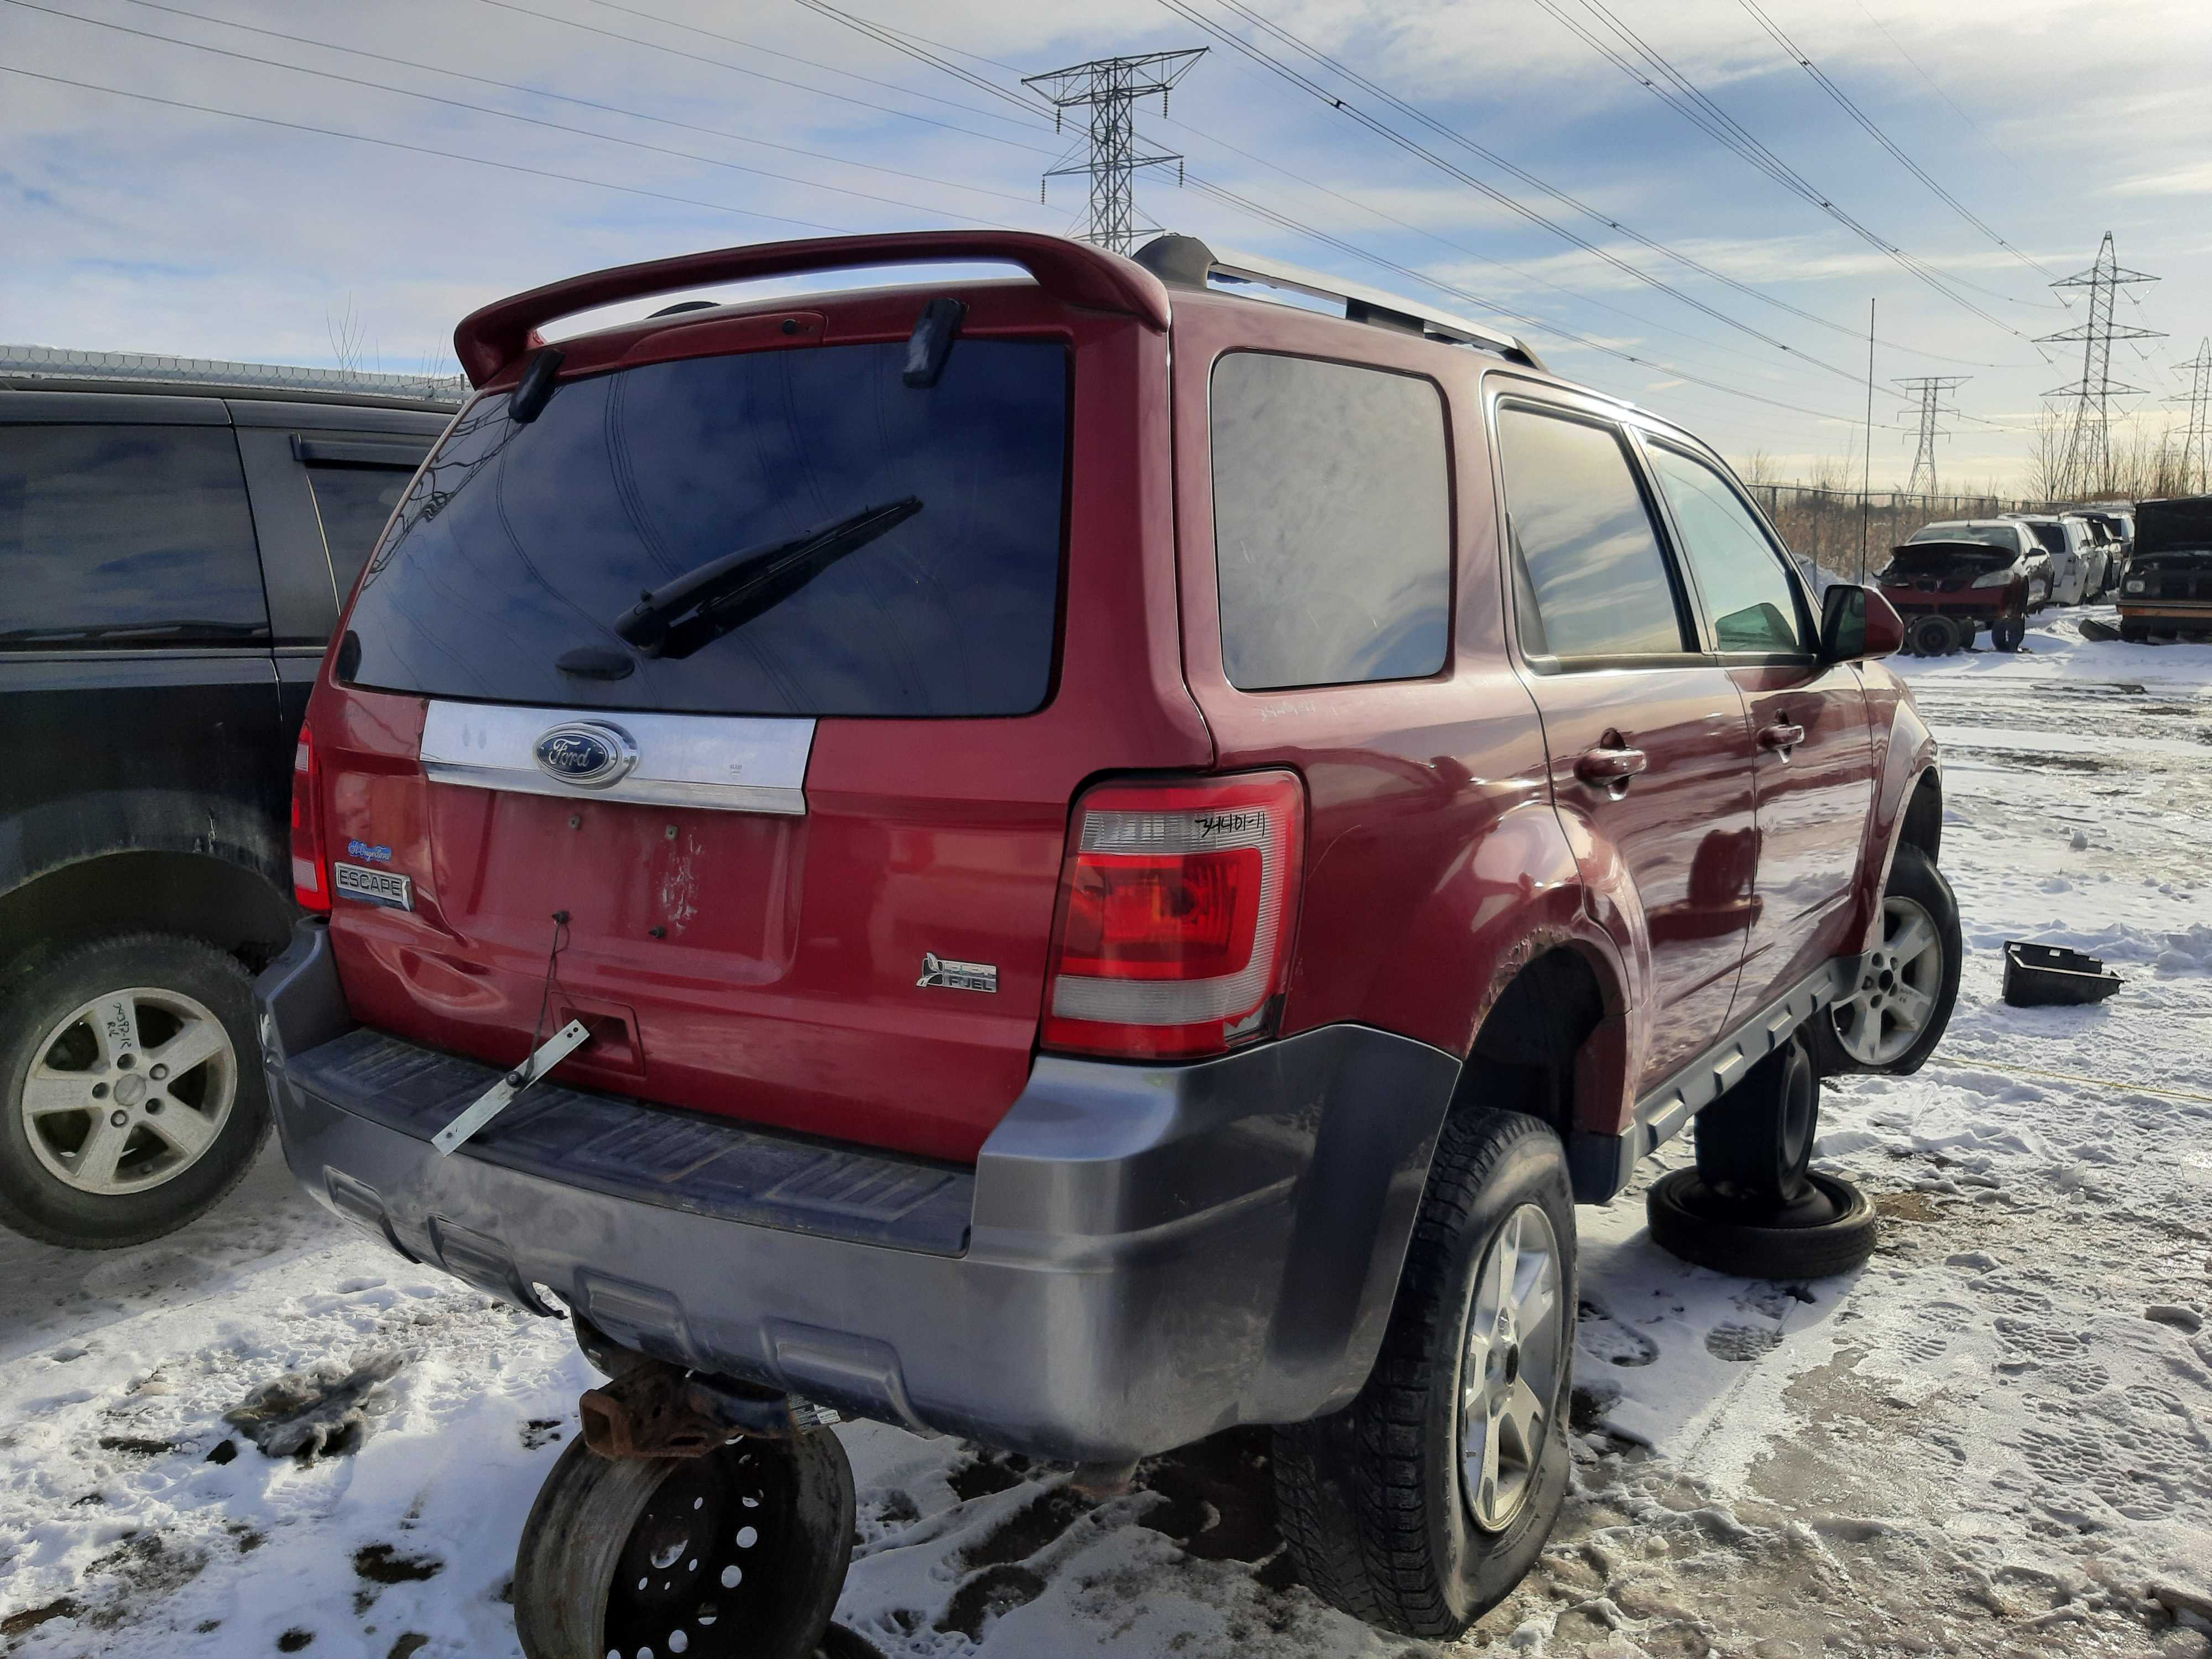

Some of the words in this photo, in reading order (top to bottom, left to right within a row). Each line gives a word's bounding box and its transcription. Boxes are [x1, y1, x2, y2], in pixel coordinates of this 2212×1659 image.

[549, 738, 592, 767] Ford
[339, 869, 401, 896] ESCAPE
[948, 975, 993, 991] FUEL
